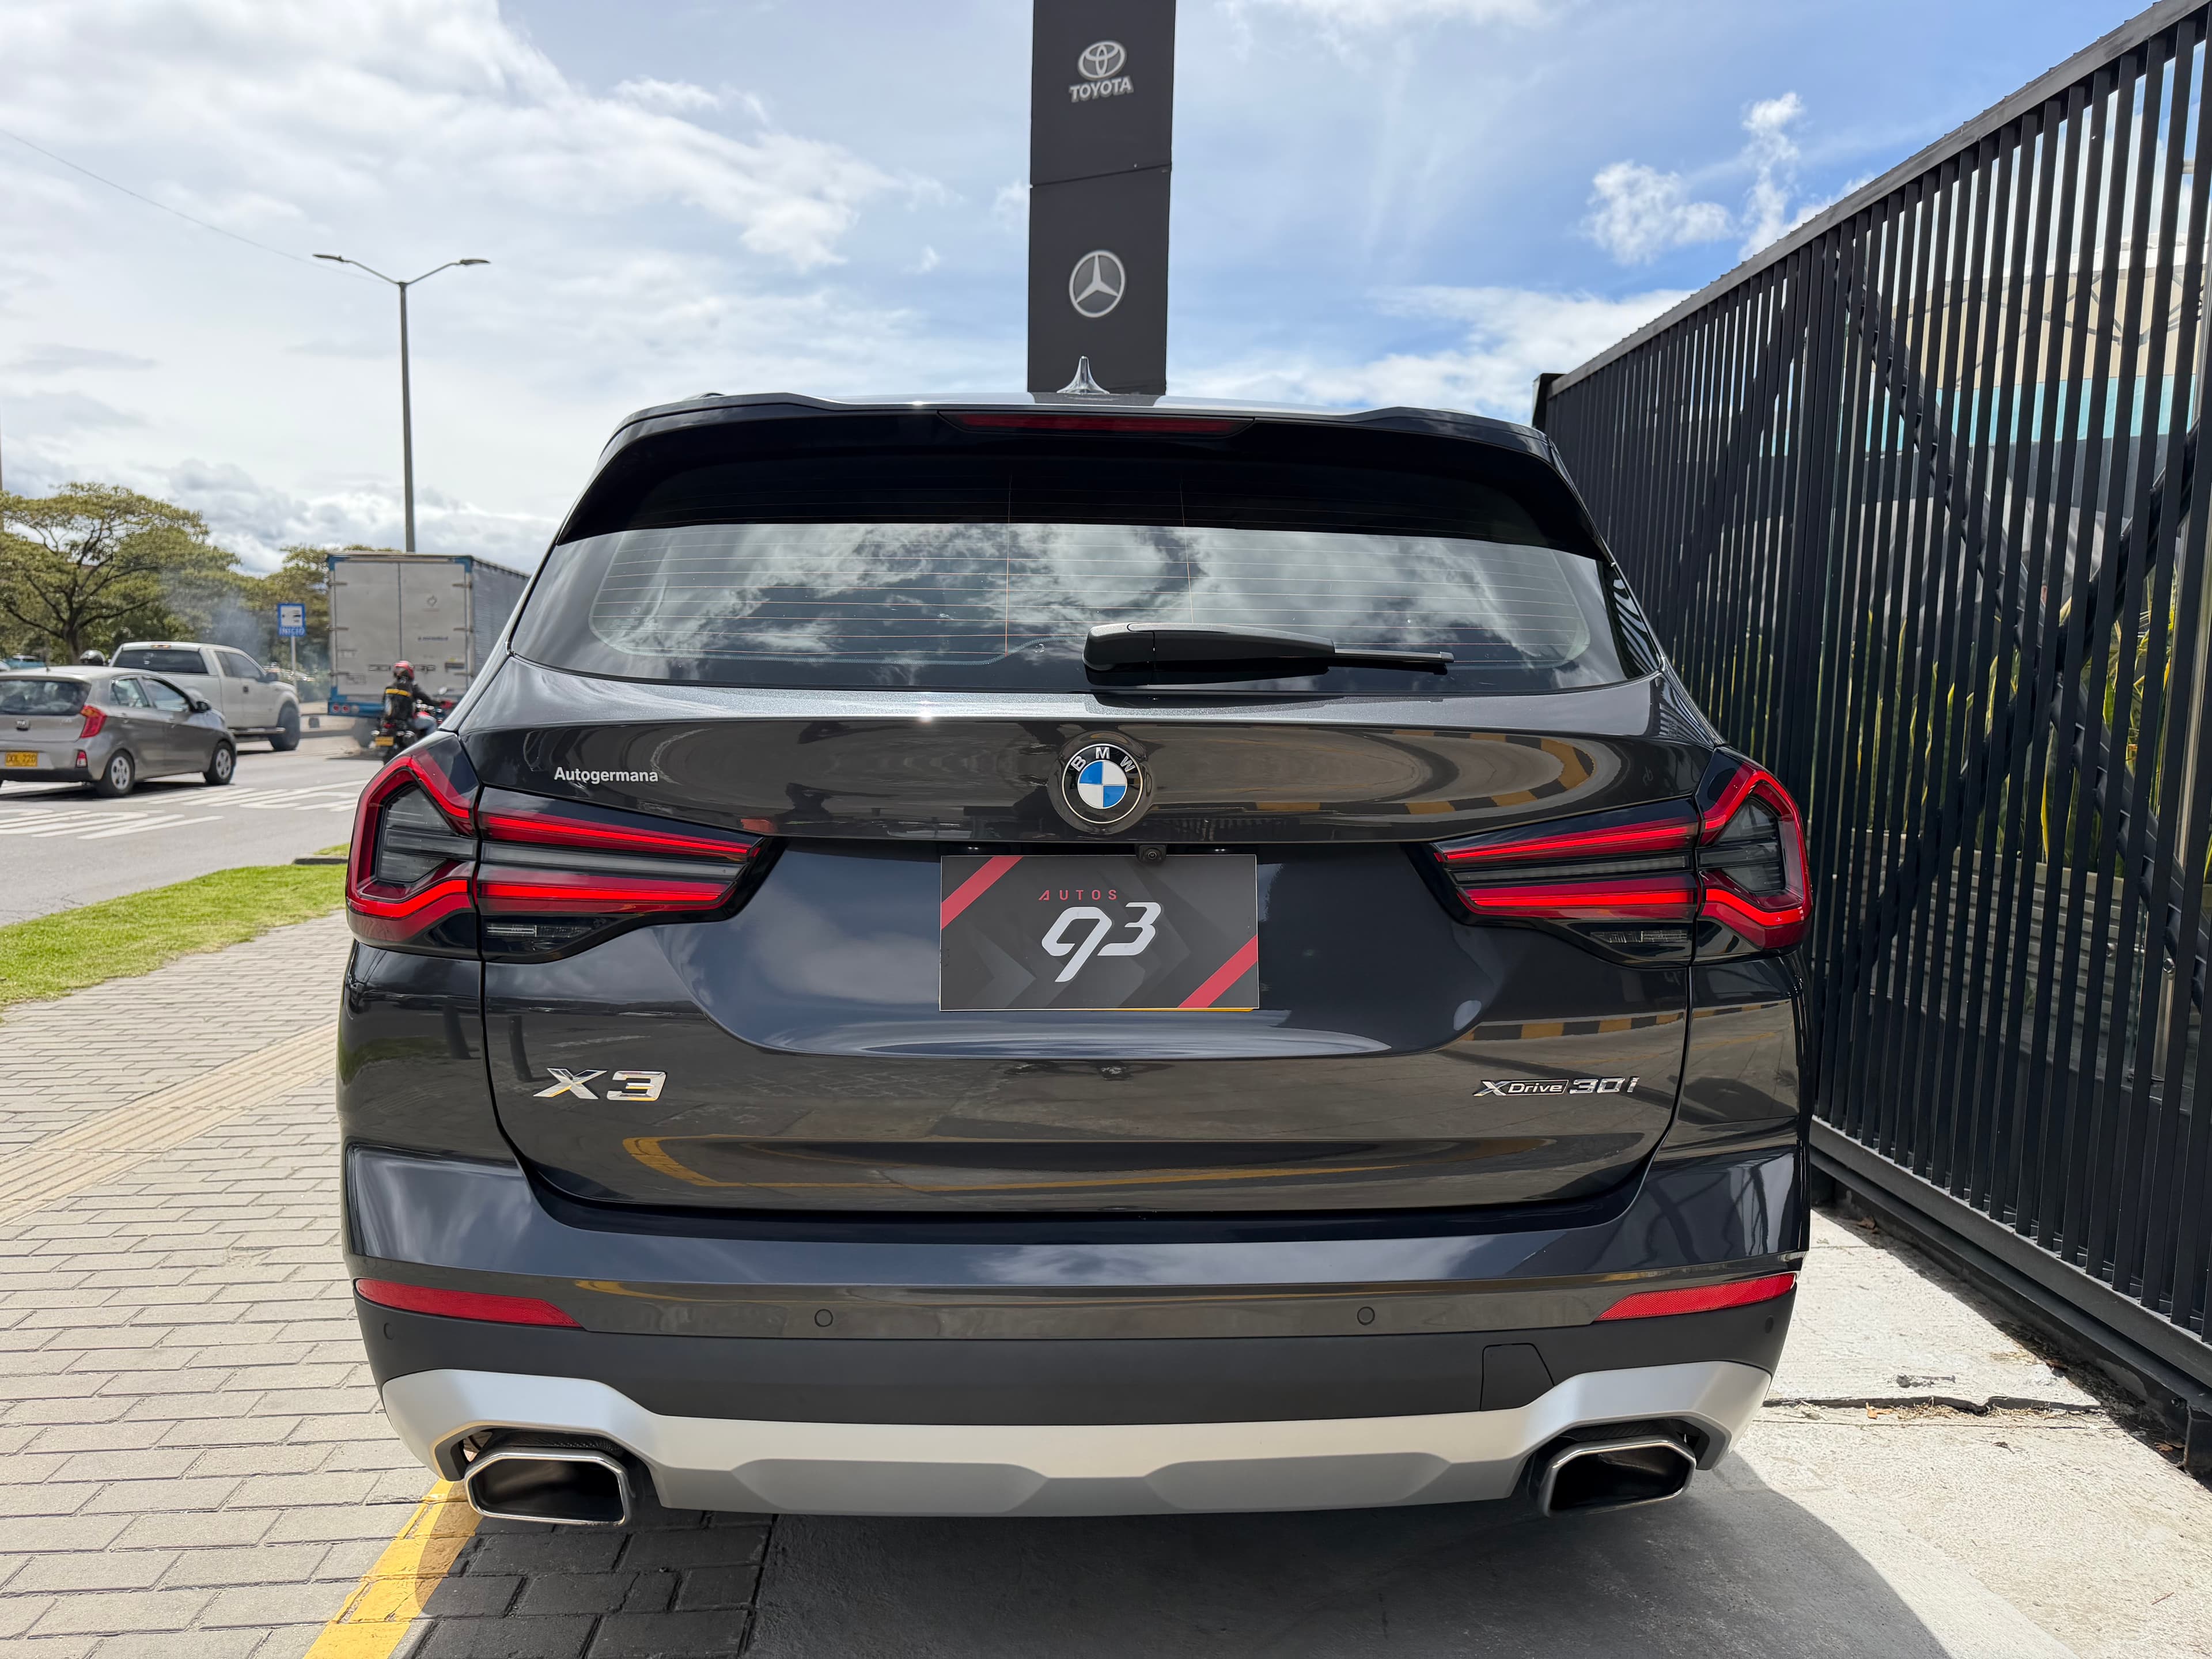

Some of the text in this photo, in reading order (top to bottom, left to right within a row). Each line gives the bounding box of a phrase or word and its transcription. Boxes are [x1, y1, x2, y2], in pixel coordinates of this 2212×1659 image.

[1069, 76, 1134, 103] TOYOTA
[1070, 747, 1136, 772] BMW
[554, 767, 658, 785] Autogermana
[1038, 889, 1118, 901] AUTOS
[1041, 902, 1161, 982] 93
[533, 1068, 666, 1101] X3
